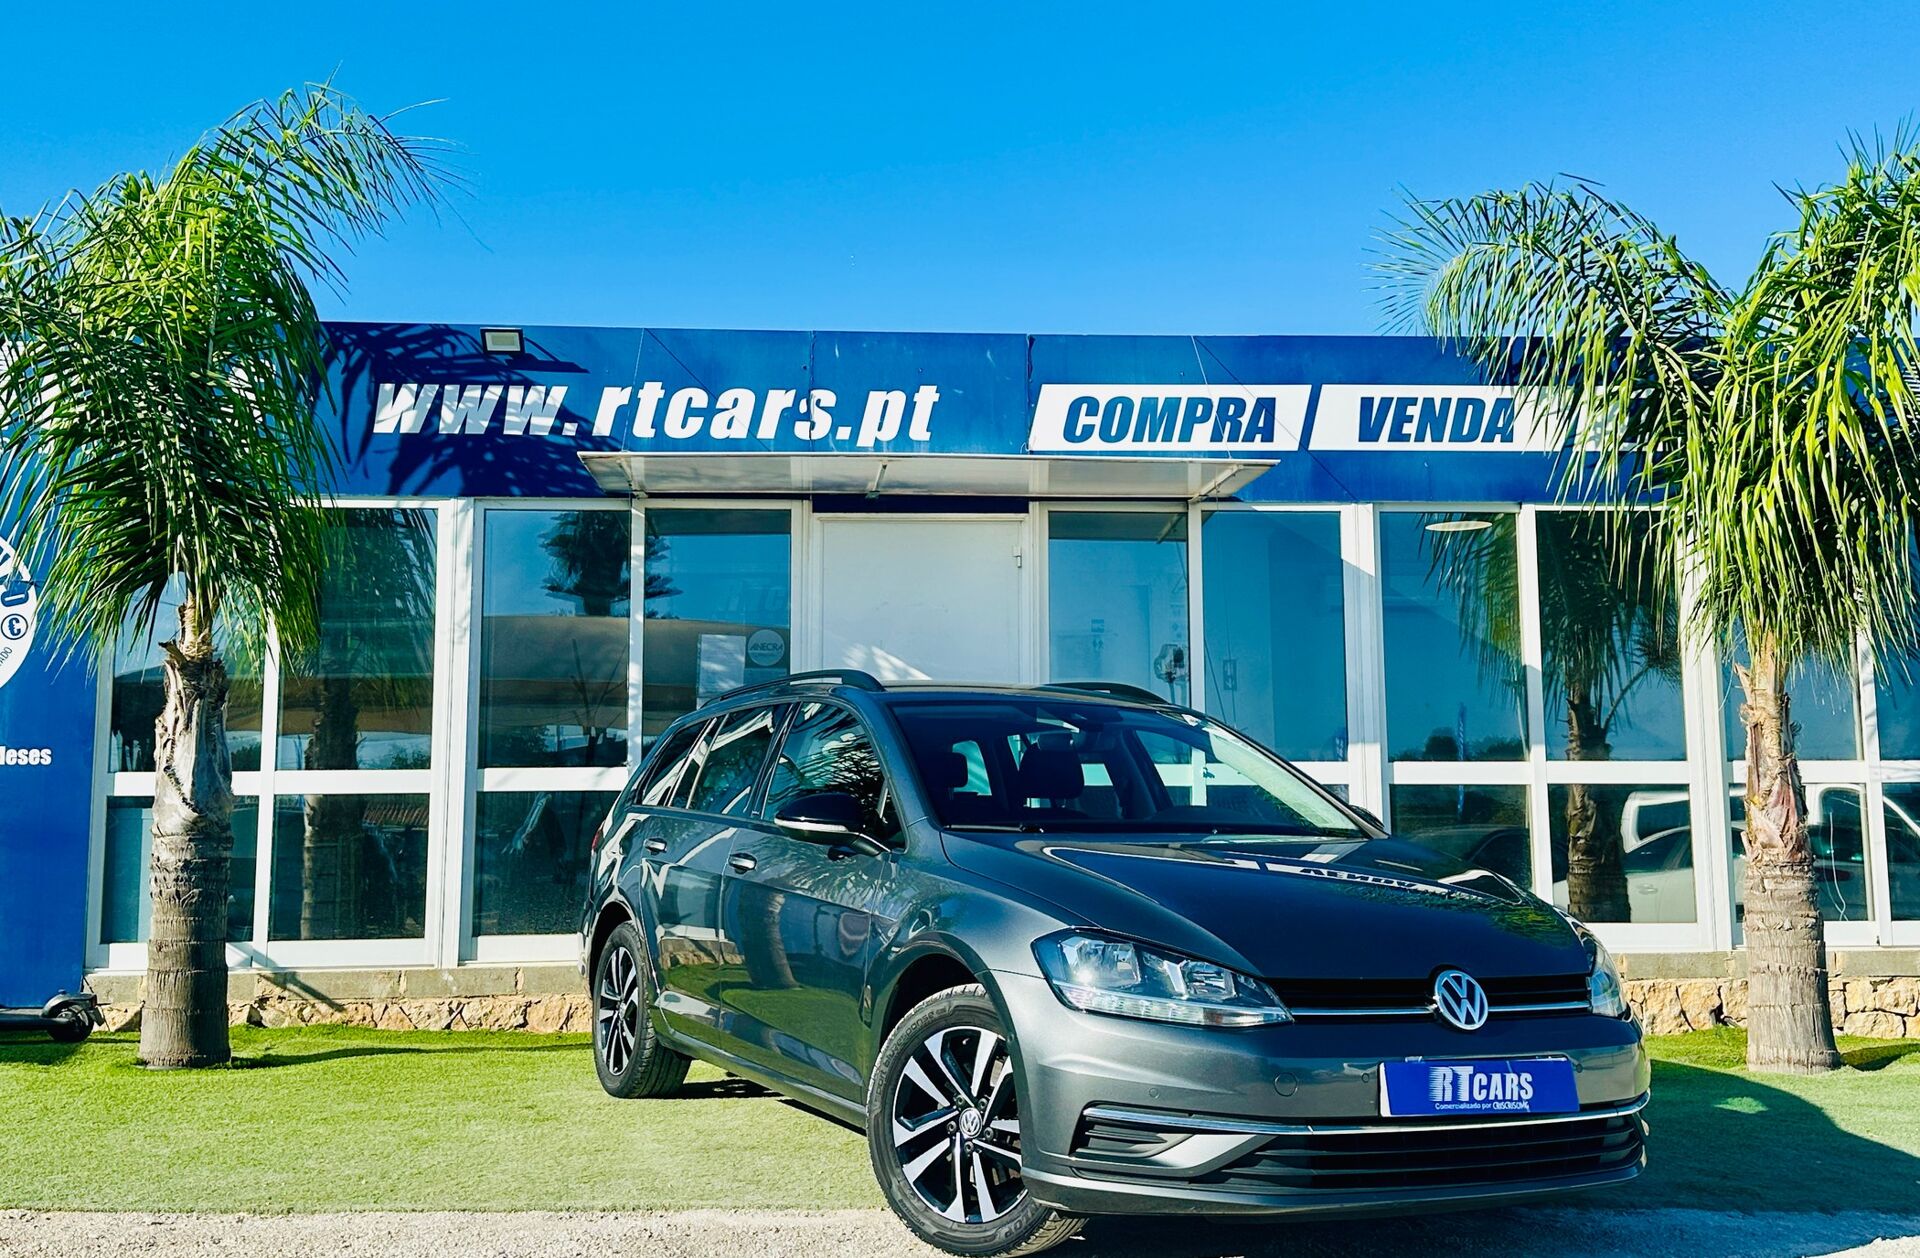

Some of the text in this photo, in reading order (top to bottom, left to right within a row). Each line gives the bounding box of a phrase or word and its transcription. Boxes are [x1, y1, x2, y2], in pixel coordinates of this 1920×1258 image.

[1063, 396, 1277, 444] COMPRA
[1358, 397, 1516, 443] VENDA
[1482, 1102, 1491, 1110] por
